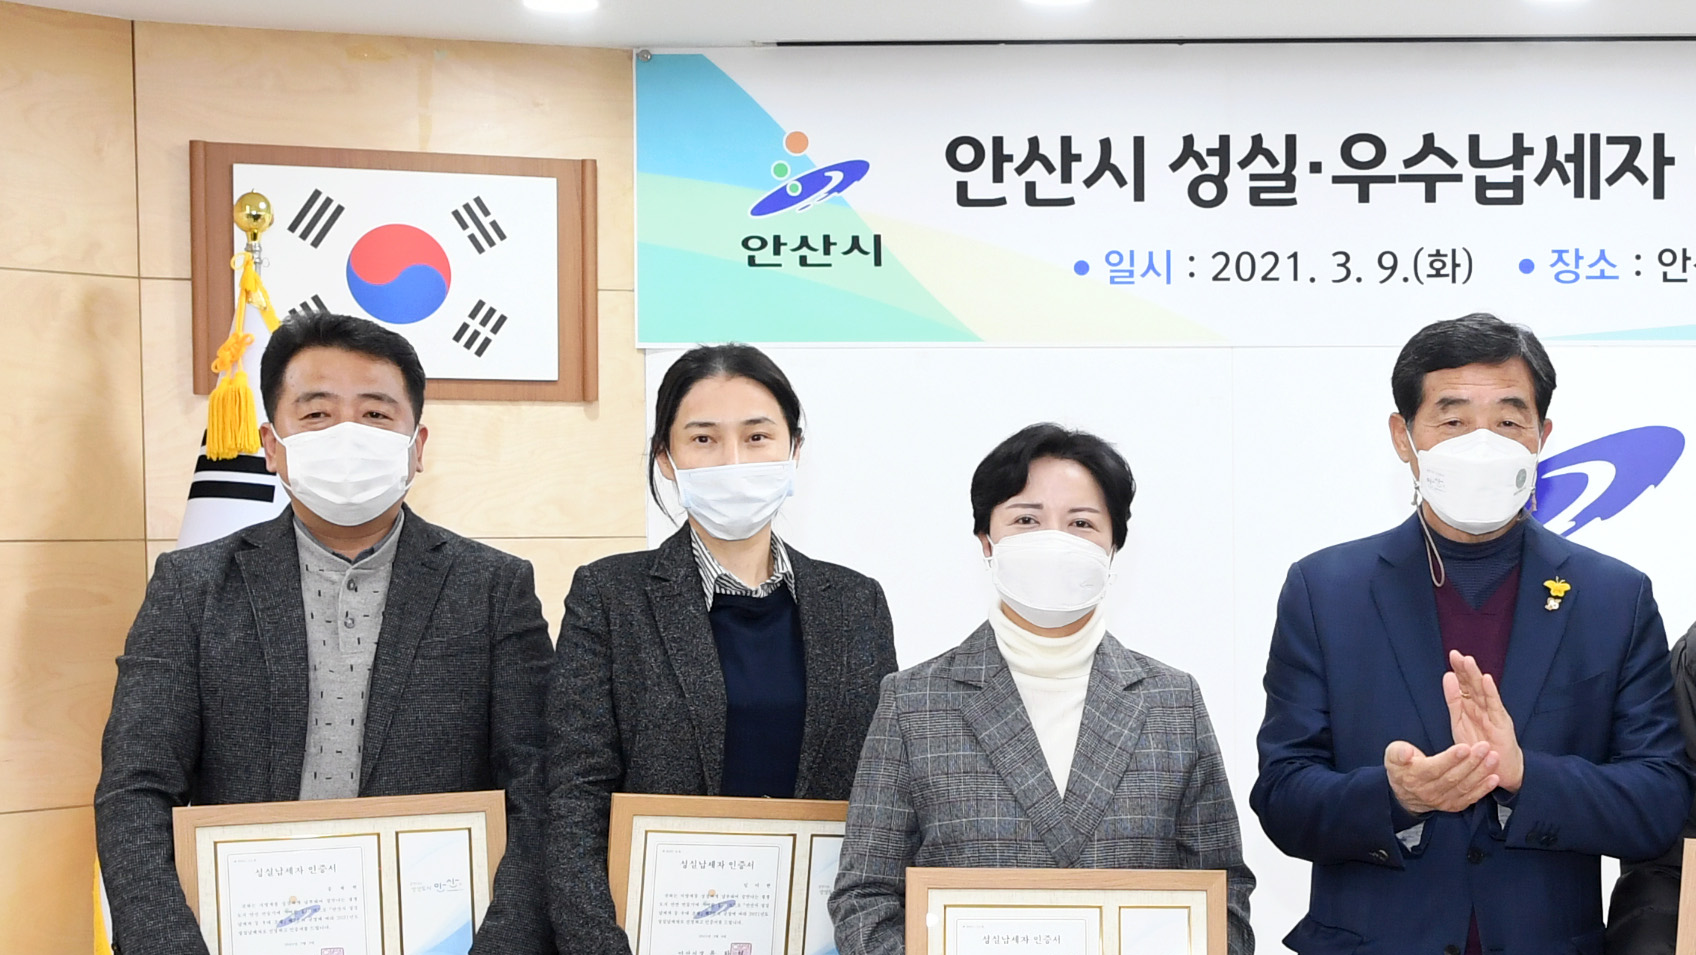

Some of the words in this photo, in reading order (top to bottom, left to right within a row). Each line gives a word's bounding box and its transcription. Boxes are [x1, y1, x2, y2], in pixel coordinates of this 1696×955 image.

[945, 136, 1145, 208] 안산시
[1169, 131, 1675, 208] 성실·우수납세자
[741, 234, 882, 268] 안산시
[1105, 249, 1171, 285] 일시
[1212, 251, 1315, 283] 2021.
[1332, 251, 1362, 283] 3.
[1378, 247, 1472, 286] 9.(화)
[1550, 248, 1619, 285] 장소
